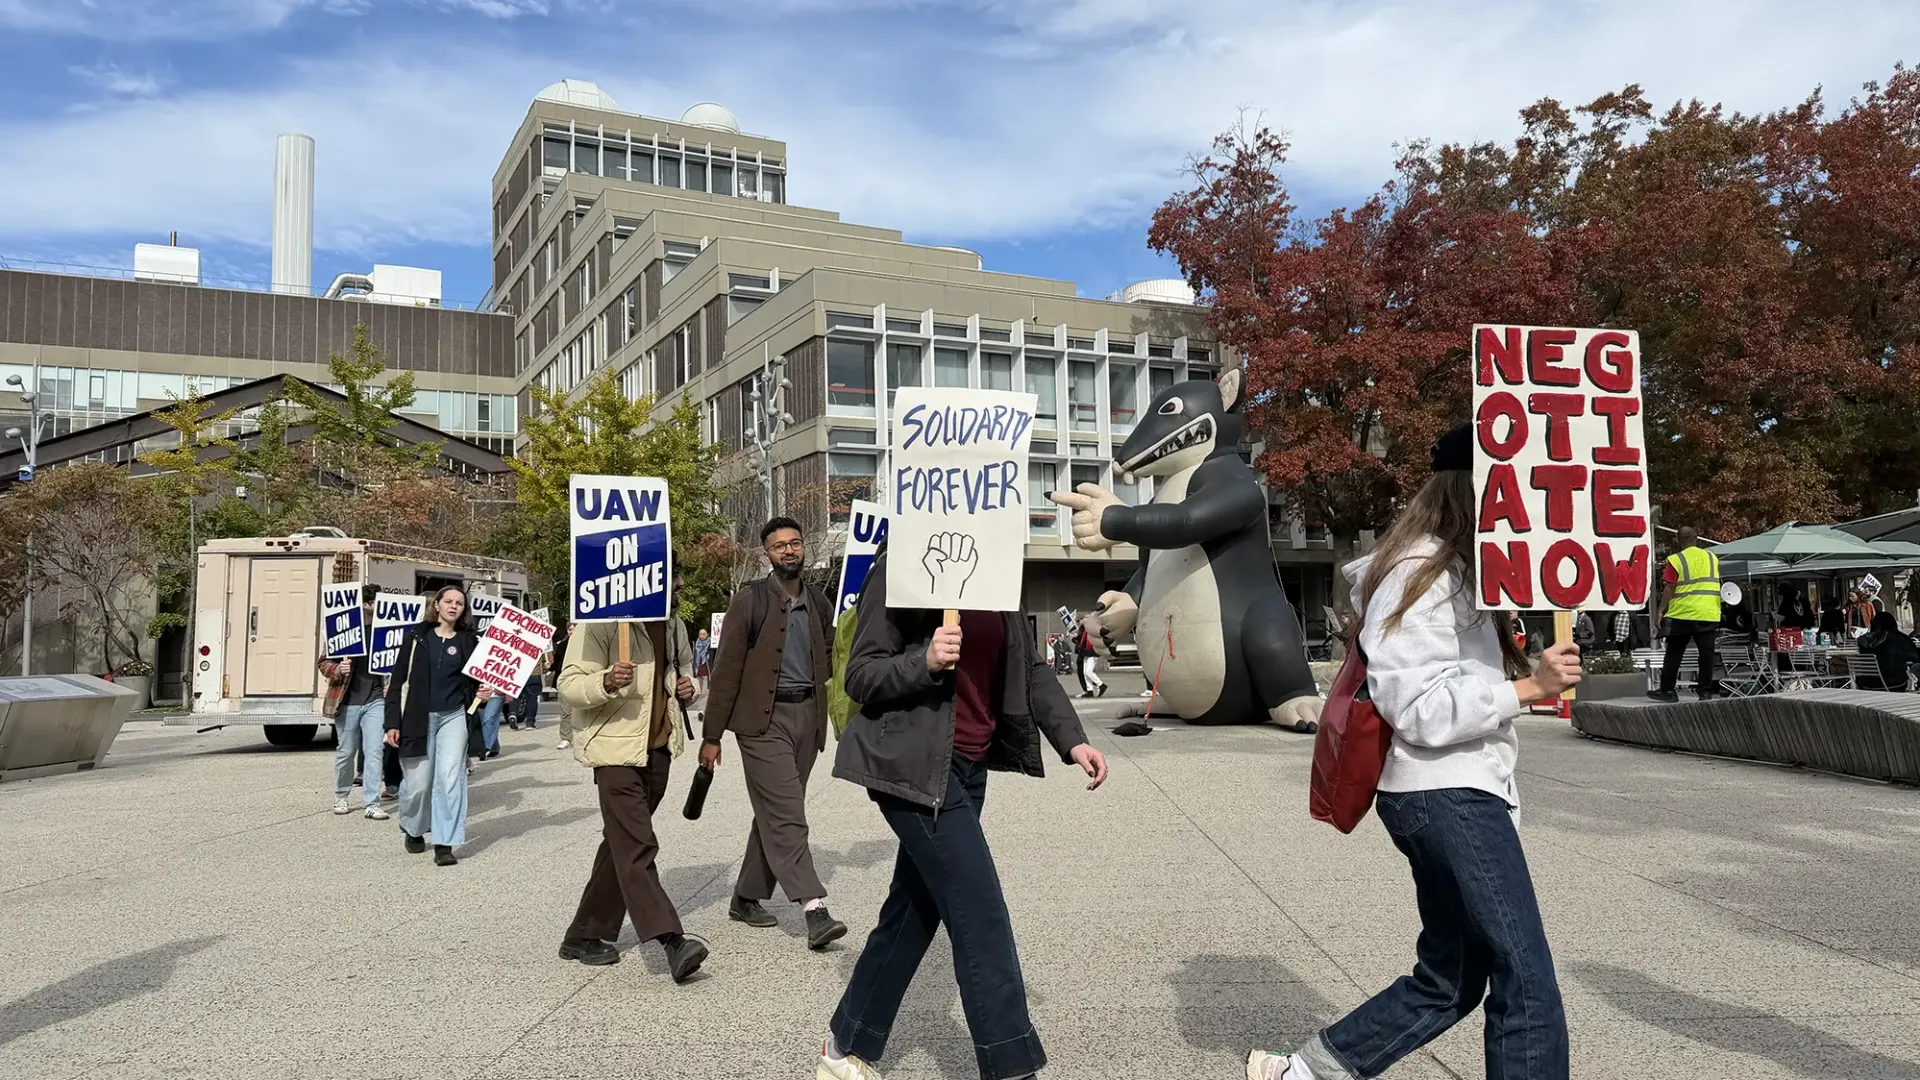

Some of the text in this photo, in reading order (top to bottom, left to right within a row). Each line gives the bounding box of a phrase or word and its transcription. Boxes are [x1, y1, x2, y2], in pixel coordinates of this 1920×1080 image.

[1476, 327, 1633, 393] NEG
[902, 404, 1032, 450] SOLIDARITY
[1477, 391, 1640, 465] OTI
[576, 488, 661, 521] UAW
[897, 460, 1021, 516] FOREVER
[1478, 463, 1647, 538] ATE
[853, 512, 889, 545] UA
[605, 533, 639, 571] ON
[579, 561, 664, 614] STRIKE
[1480, 538, 1649, 608] NOW
[1866, 575, 1880, 589] UAW
[324, 589, 358, 608] UAW
[376, 600, 421, 622] UAW
[335, 613, 350, 633] ON
[385, 629, 404, 648] ON
[500, 607, 553, 639] TEACHERS
[328, 626, 361, 654] STRIKE
[485, 625, 543, 660] RESEARCHERS
[483, 659, 517, 680] FAIR
[488, 645, 521, 669] FOR A
[469, 665, 521, 695] CONTRACT
